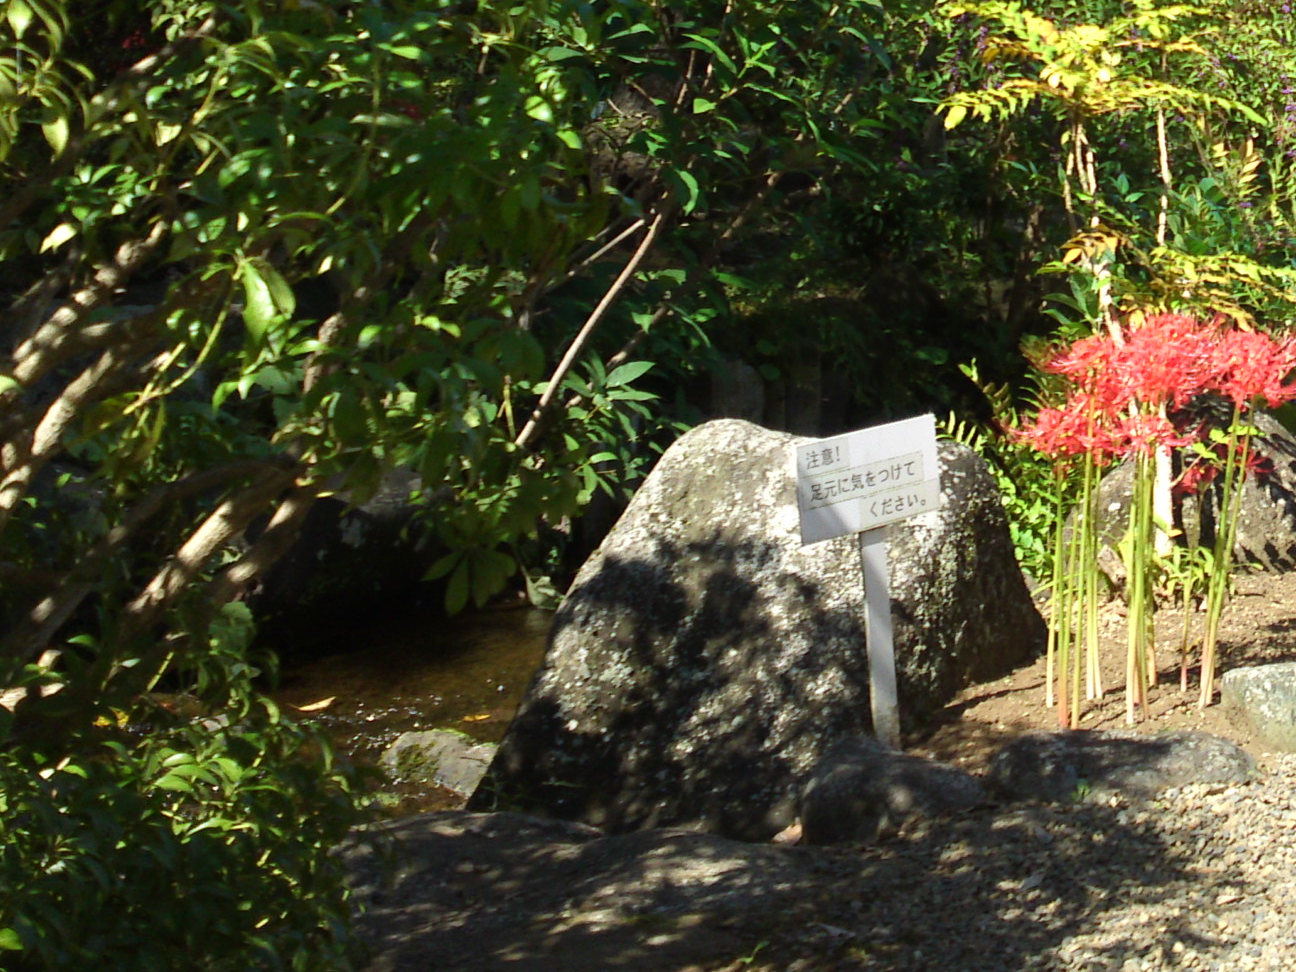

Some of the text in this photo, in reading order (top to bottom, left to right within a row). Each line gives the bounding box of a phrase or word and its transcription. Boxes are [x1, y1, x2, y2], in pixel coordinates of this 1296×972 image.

[810, 461, 915, 502] 足元に気をつけて
[870, 494, 926, 517] ください。
